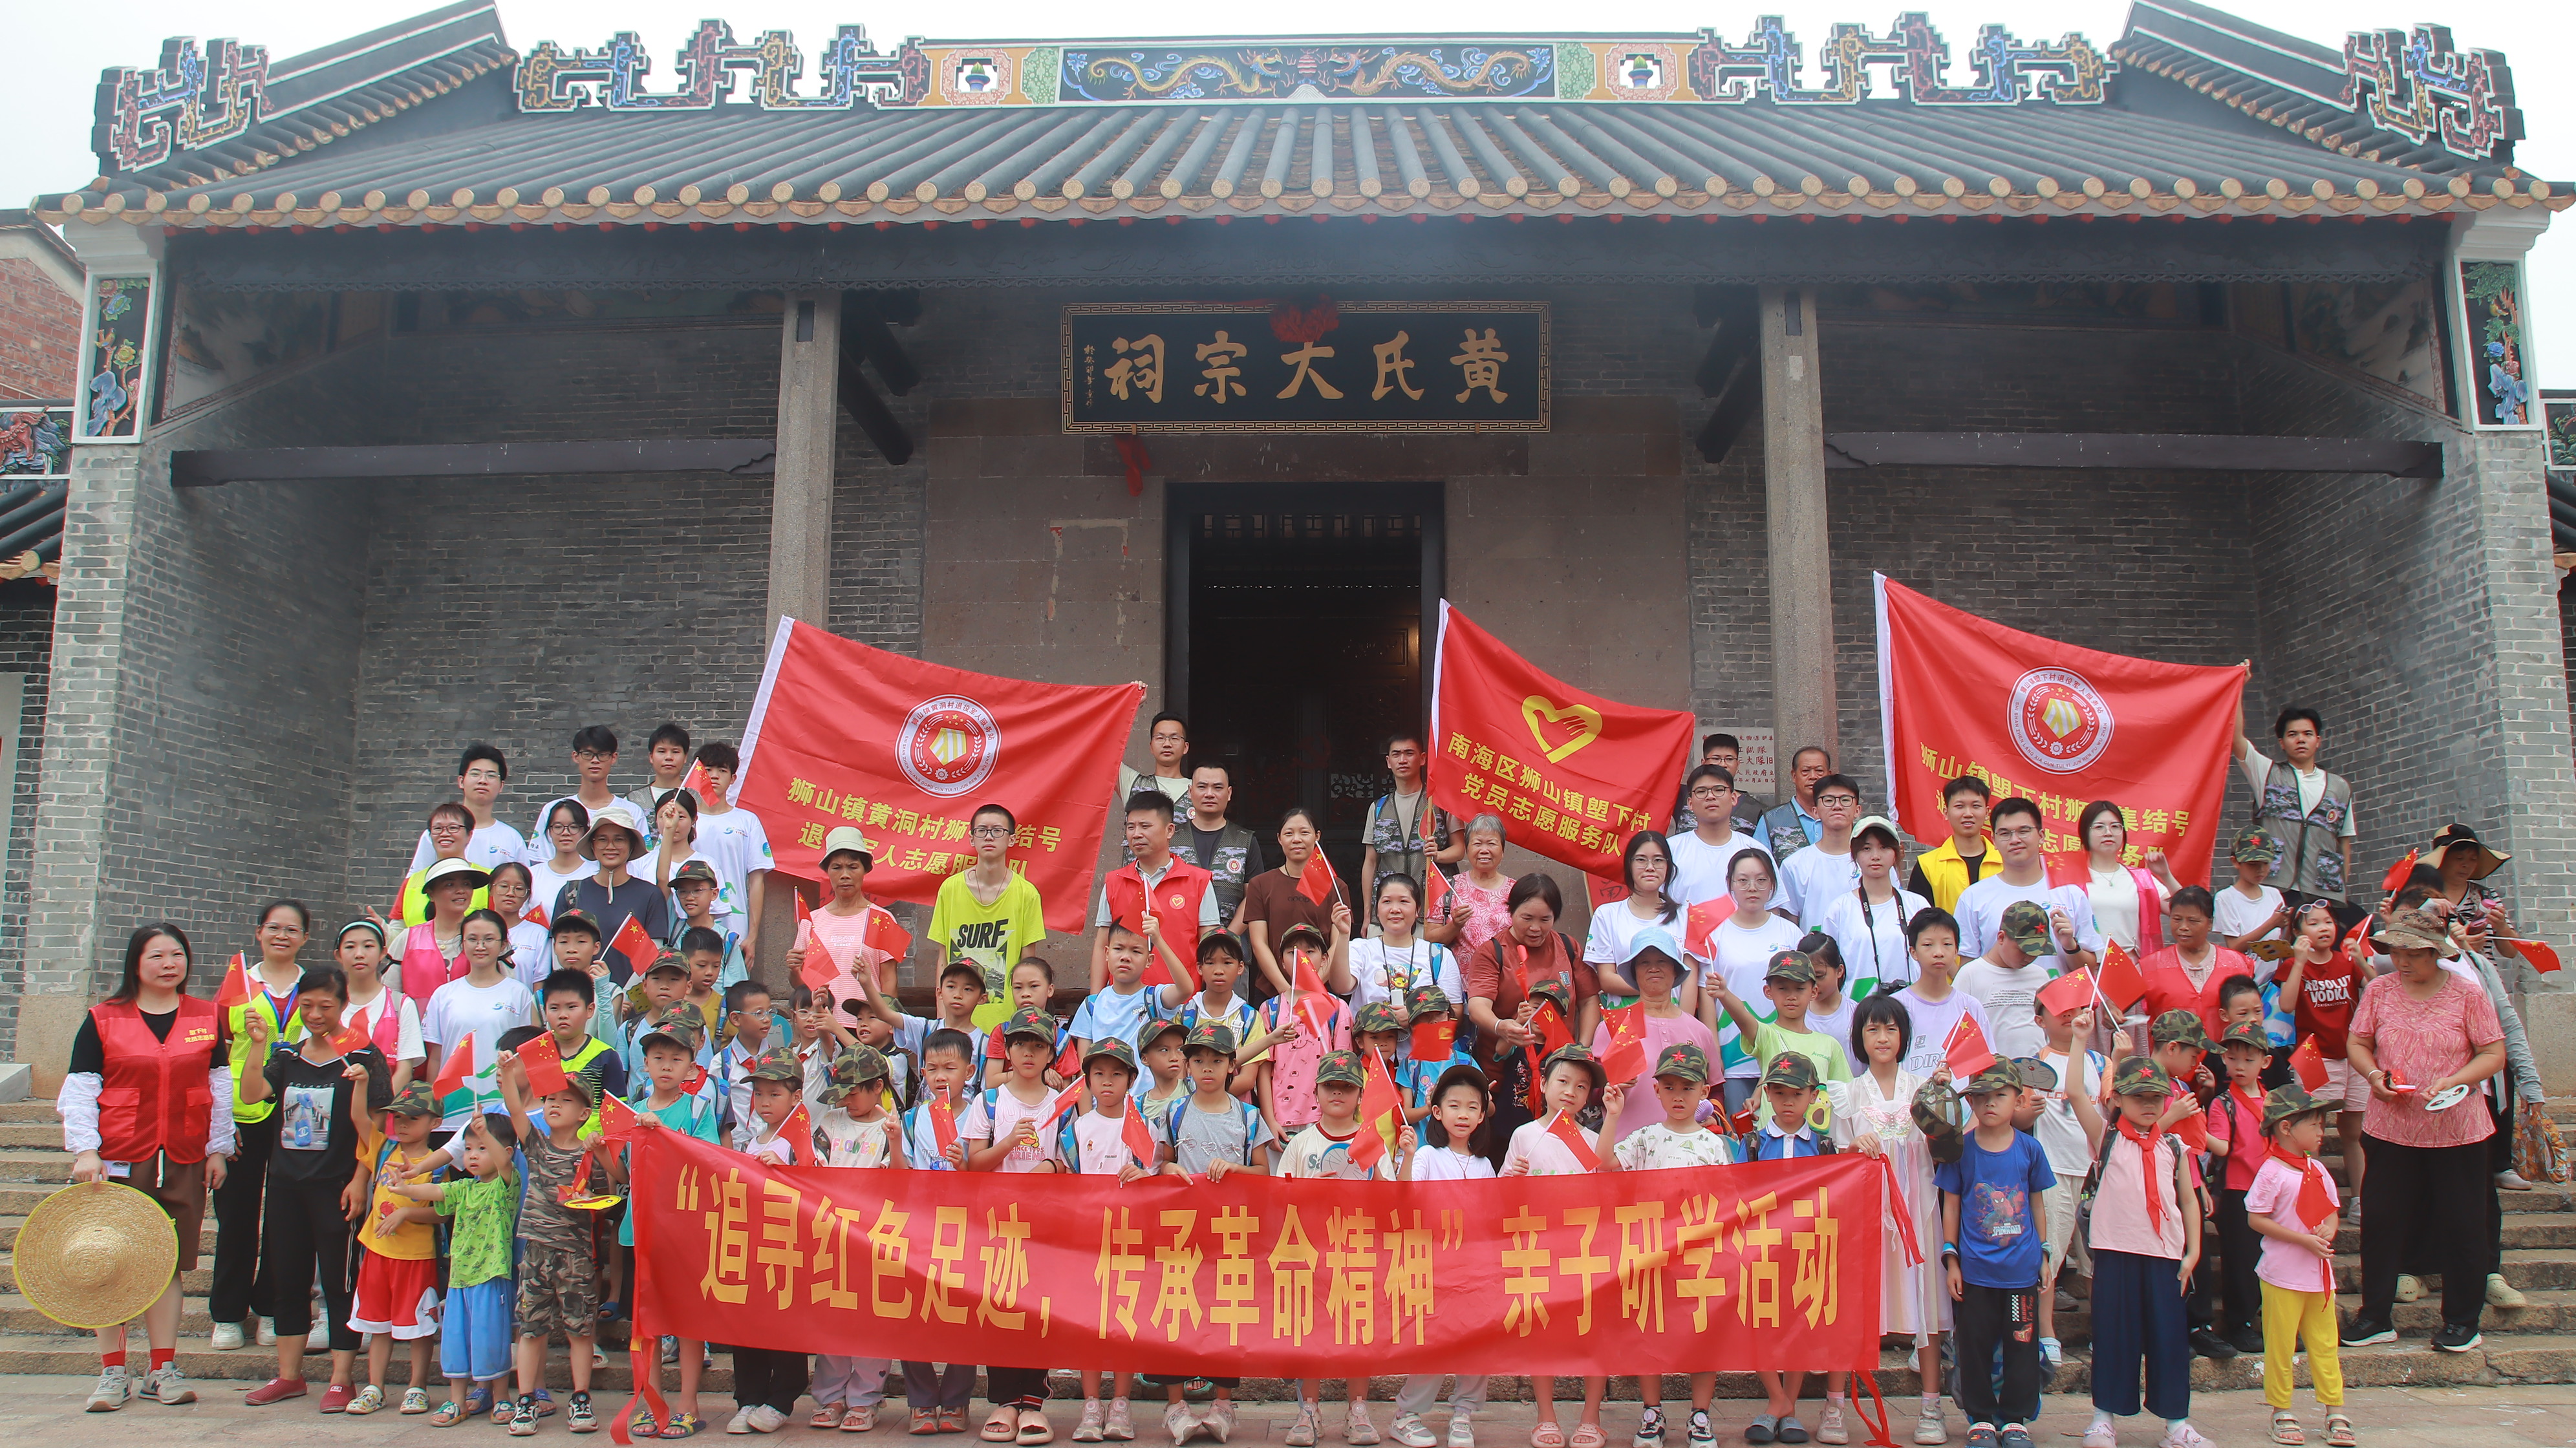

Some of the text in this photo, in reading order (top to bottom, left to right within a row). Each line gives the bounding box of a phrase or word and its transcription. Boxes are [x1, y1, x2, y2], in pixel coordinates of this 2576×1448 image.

[1104, 328, 1509, 403] 黄氏大宗祠
[2015, 729, 2024, 743] ZHEN
[2023, 743, 2034, 756] LANG
[908, 769, 921, 782] HUANG
[1447, 731, 1651, 832] 南海区狮山镇塱下村
[1920, 742, 2190, 837] 狮山镇塱下村狮集结号
[787, 776, 1062, 853] 狮山镇黄洞村狮结号
[1461, 772, 1622, 857] 党员志愿服务队
[957, 918, 1010, 949] SURF
[2310, 987, 2352, 1008] VODKA
[832, 1138, 877, 1156] FLOWER
